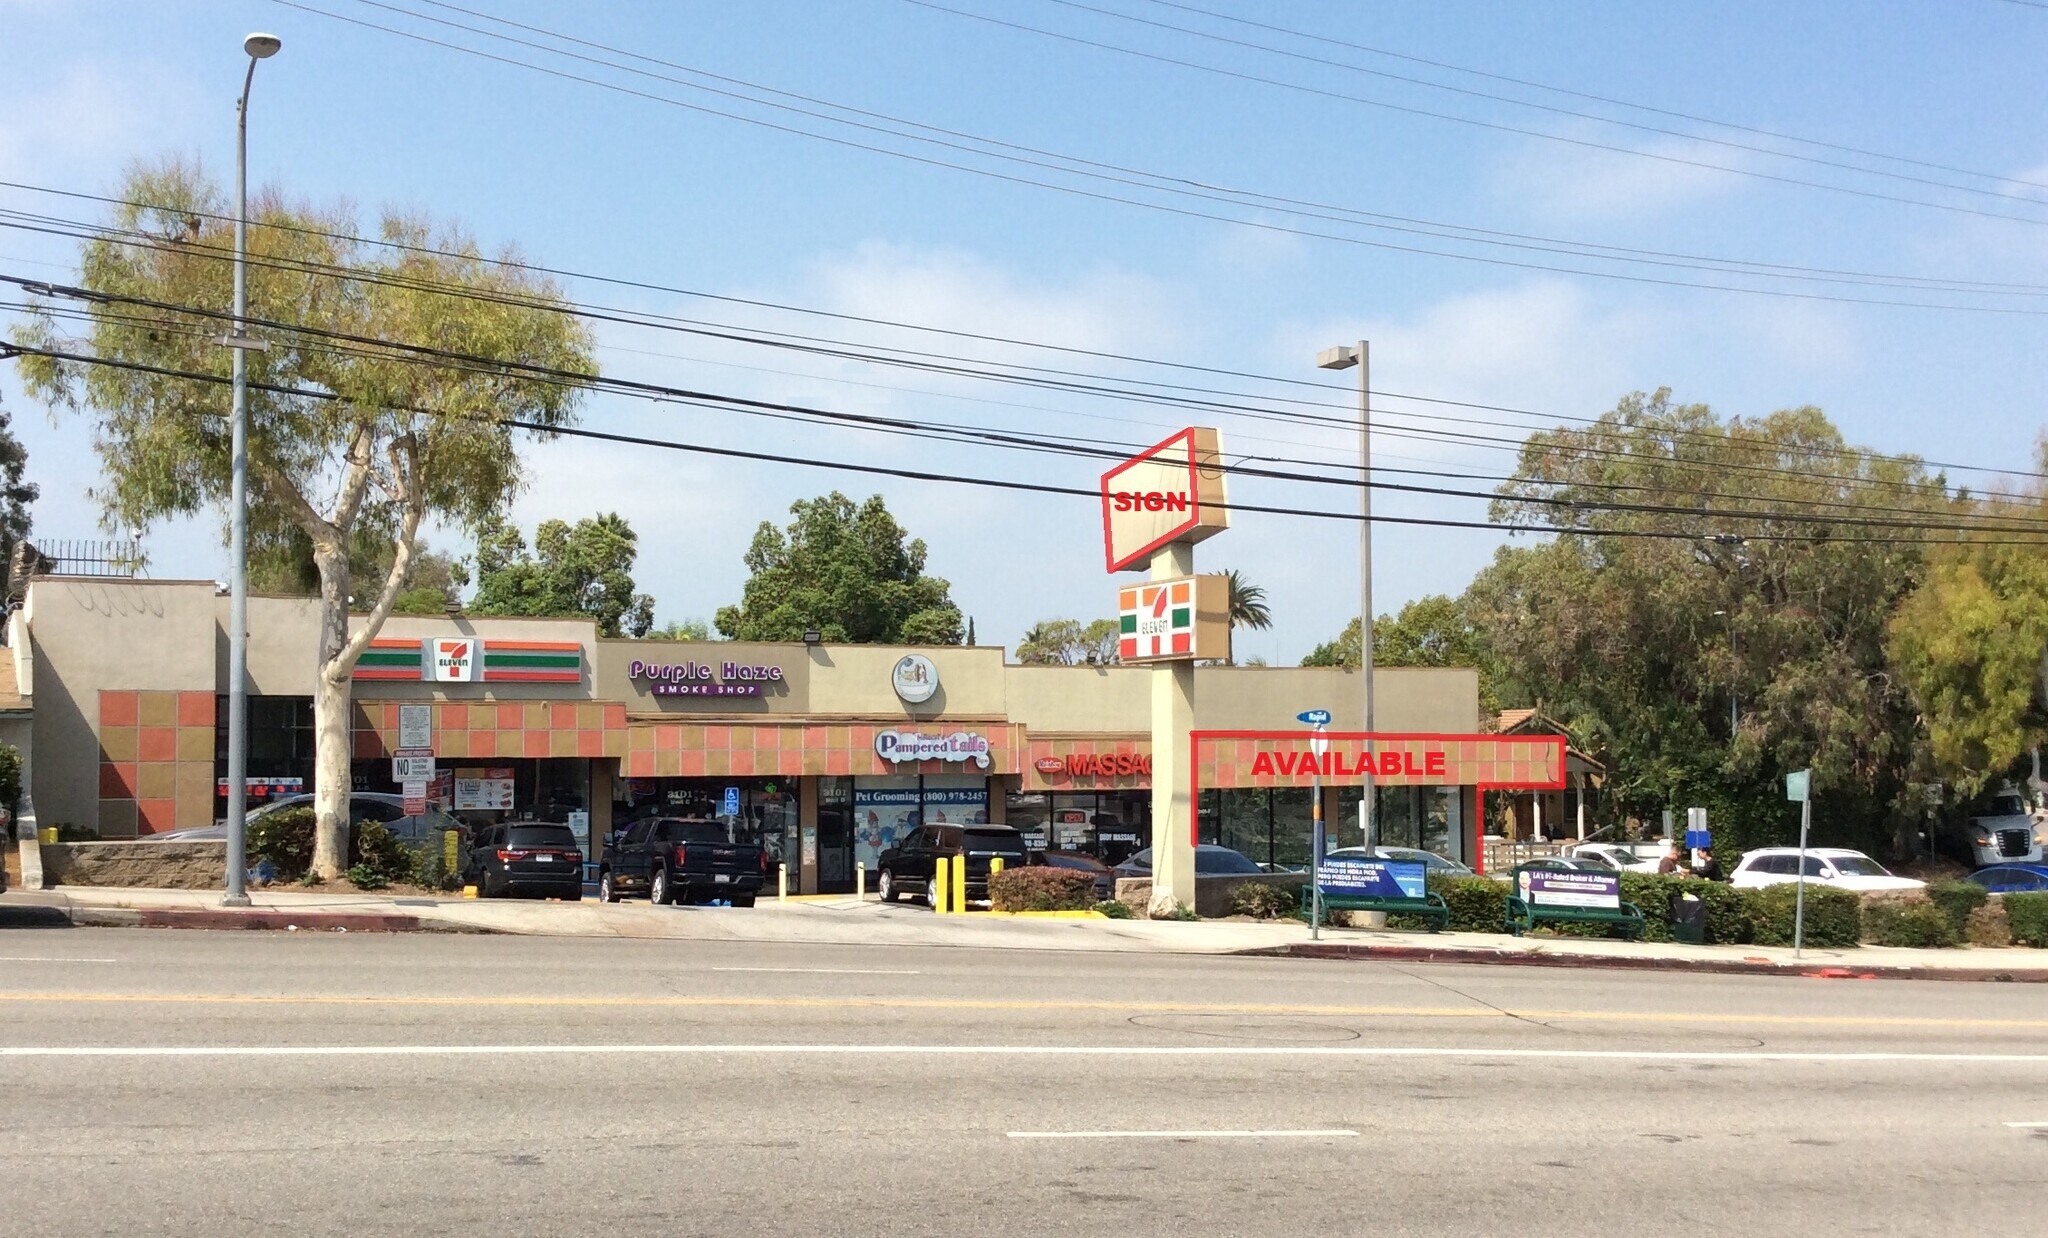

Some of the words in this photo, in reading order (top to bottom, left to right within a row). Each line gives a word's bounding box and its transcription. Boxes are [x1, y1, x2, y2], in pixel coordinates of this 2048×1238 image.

[629, 660, 712, 683] Purple
[721, 661, 783, 680] Haze
[659, 685, 708, 694] SMOKE
[717, 686, 755, 694] SHOP
[881, 735, 948, 755] Pampered
[397, 758, 409, 776] NO
[856, 791, 871, 801] Pet
[873, 791, 920, 802] Grooming
[923, 791, 947, 801] (800)
[948, 791, 988, 801] 978-2457
